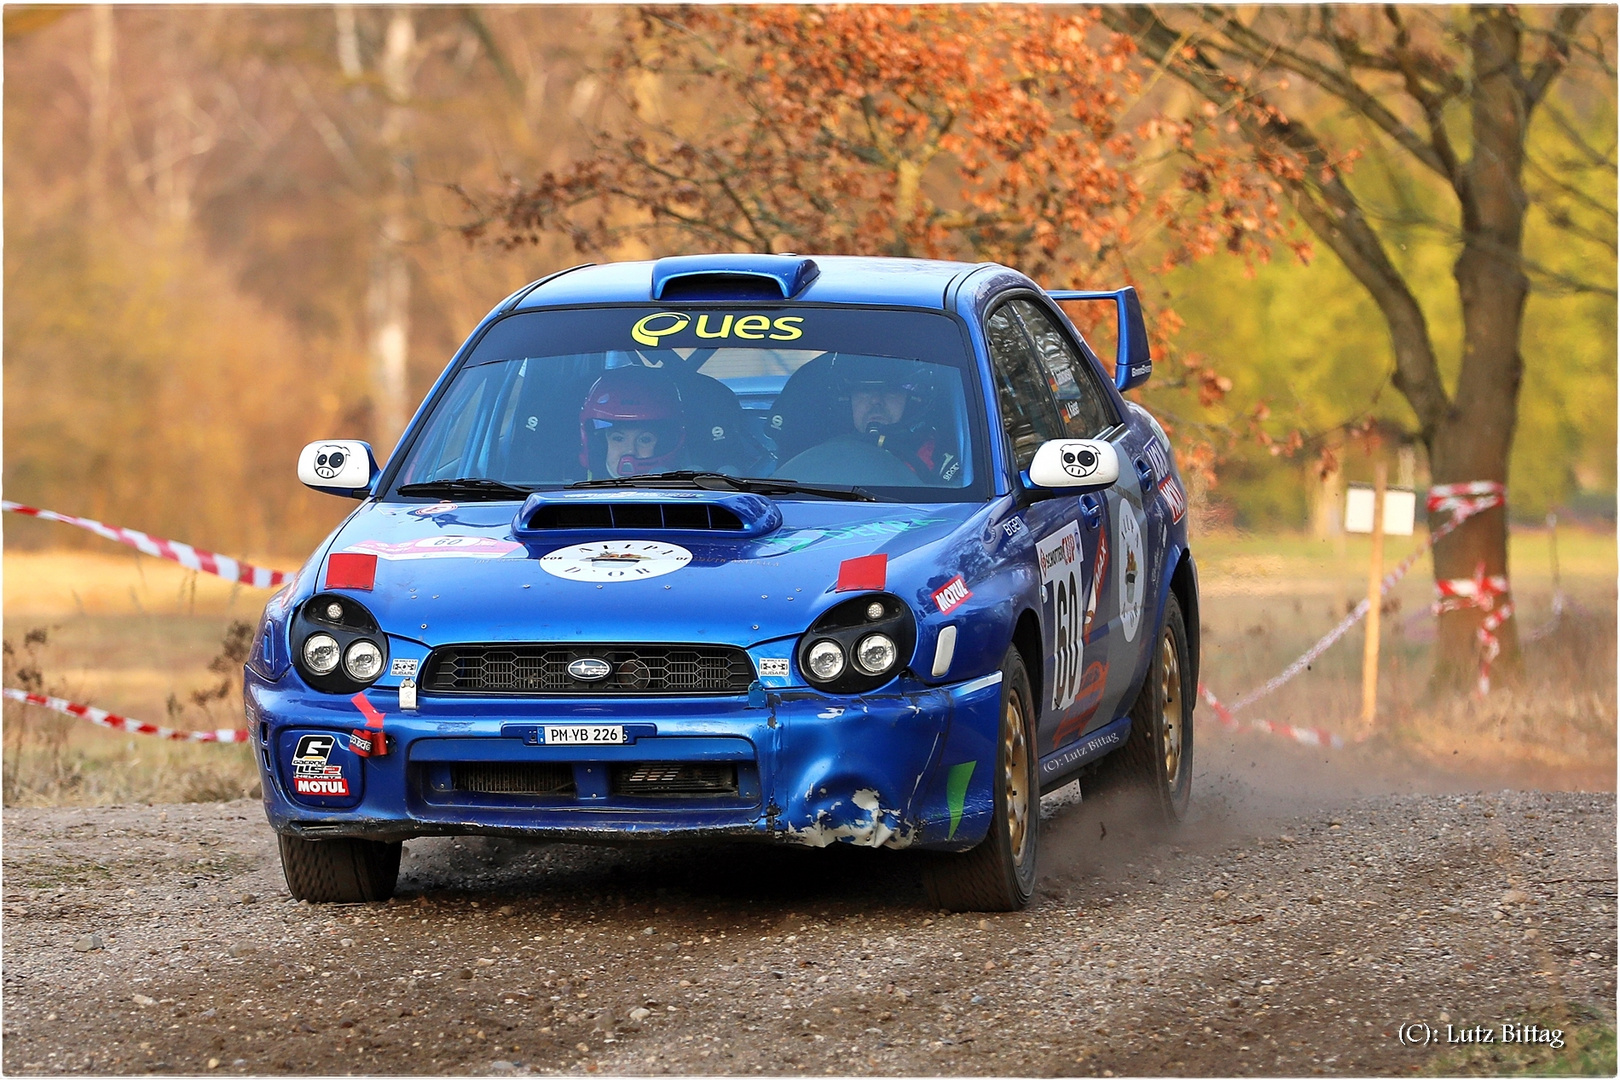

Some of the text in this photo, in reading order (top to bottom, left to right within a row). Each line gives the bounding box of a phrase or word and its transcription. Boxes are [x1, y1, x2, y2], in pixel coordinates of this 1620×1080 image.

[935, 578, 969, 612] MOTUL
[1057, 571, 1078, 707] 60
[593, 728, 618, 741] 226
[298, 780, 346, 793] MOTUL
